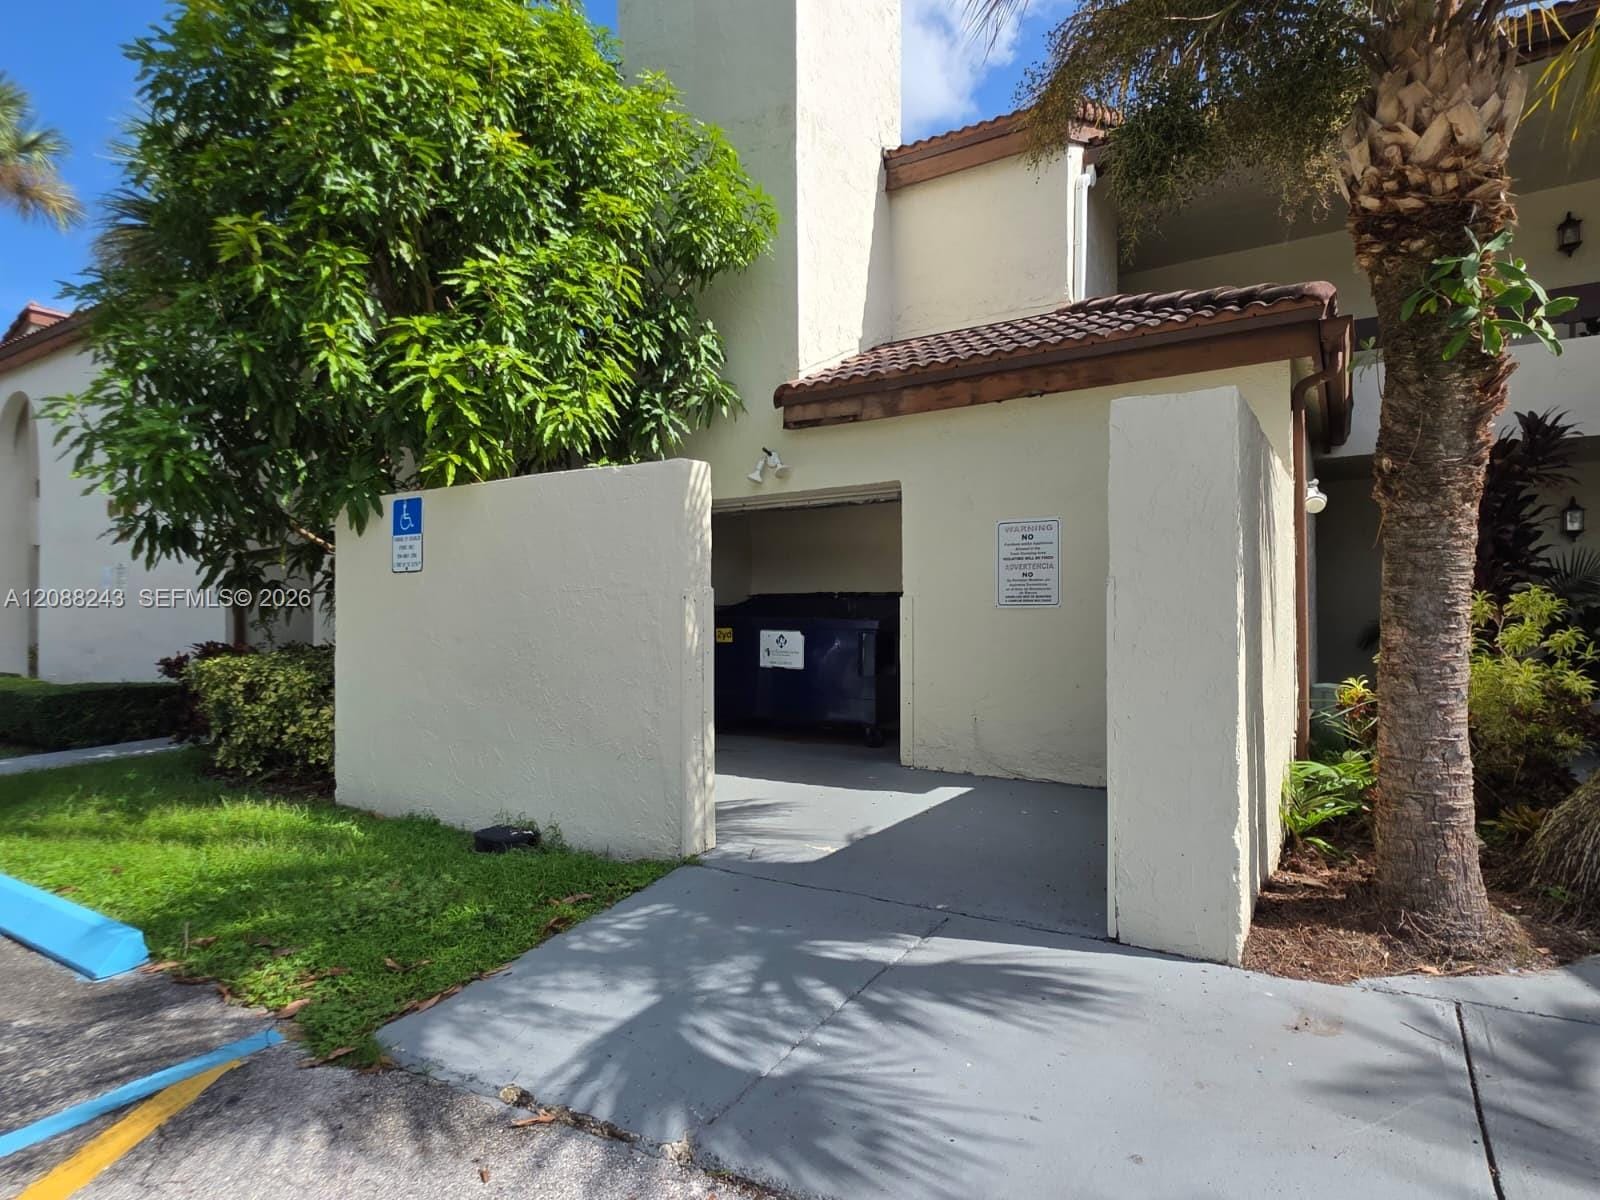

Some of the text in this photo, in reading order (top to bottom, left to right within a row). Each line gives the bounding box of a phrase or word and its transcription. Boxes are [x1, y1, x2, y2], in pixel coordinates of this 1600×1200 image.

[1005, 524, 1053, 533] WARNING
[1021, 533, 1034, 541] NO
[1005, 562, 1054, 570] ADVERTENCIA
